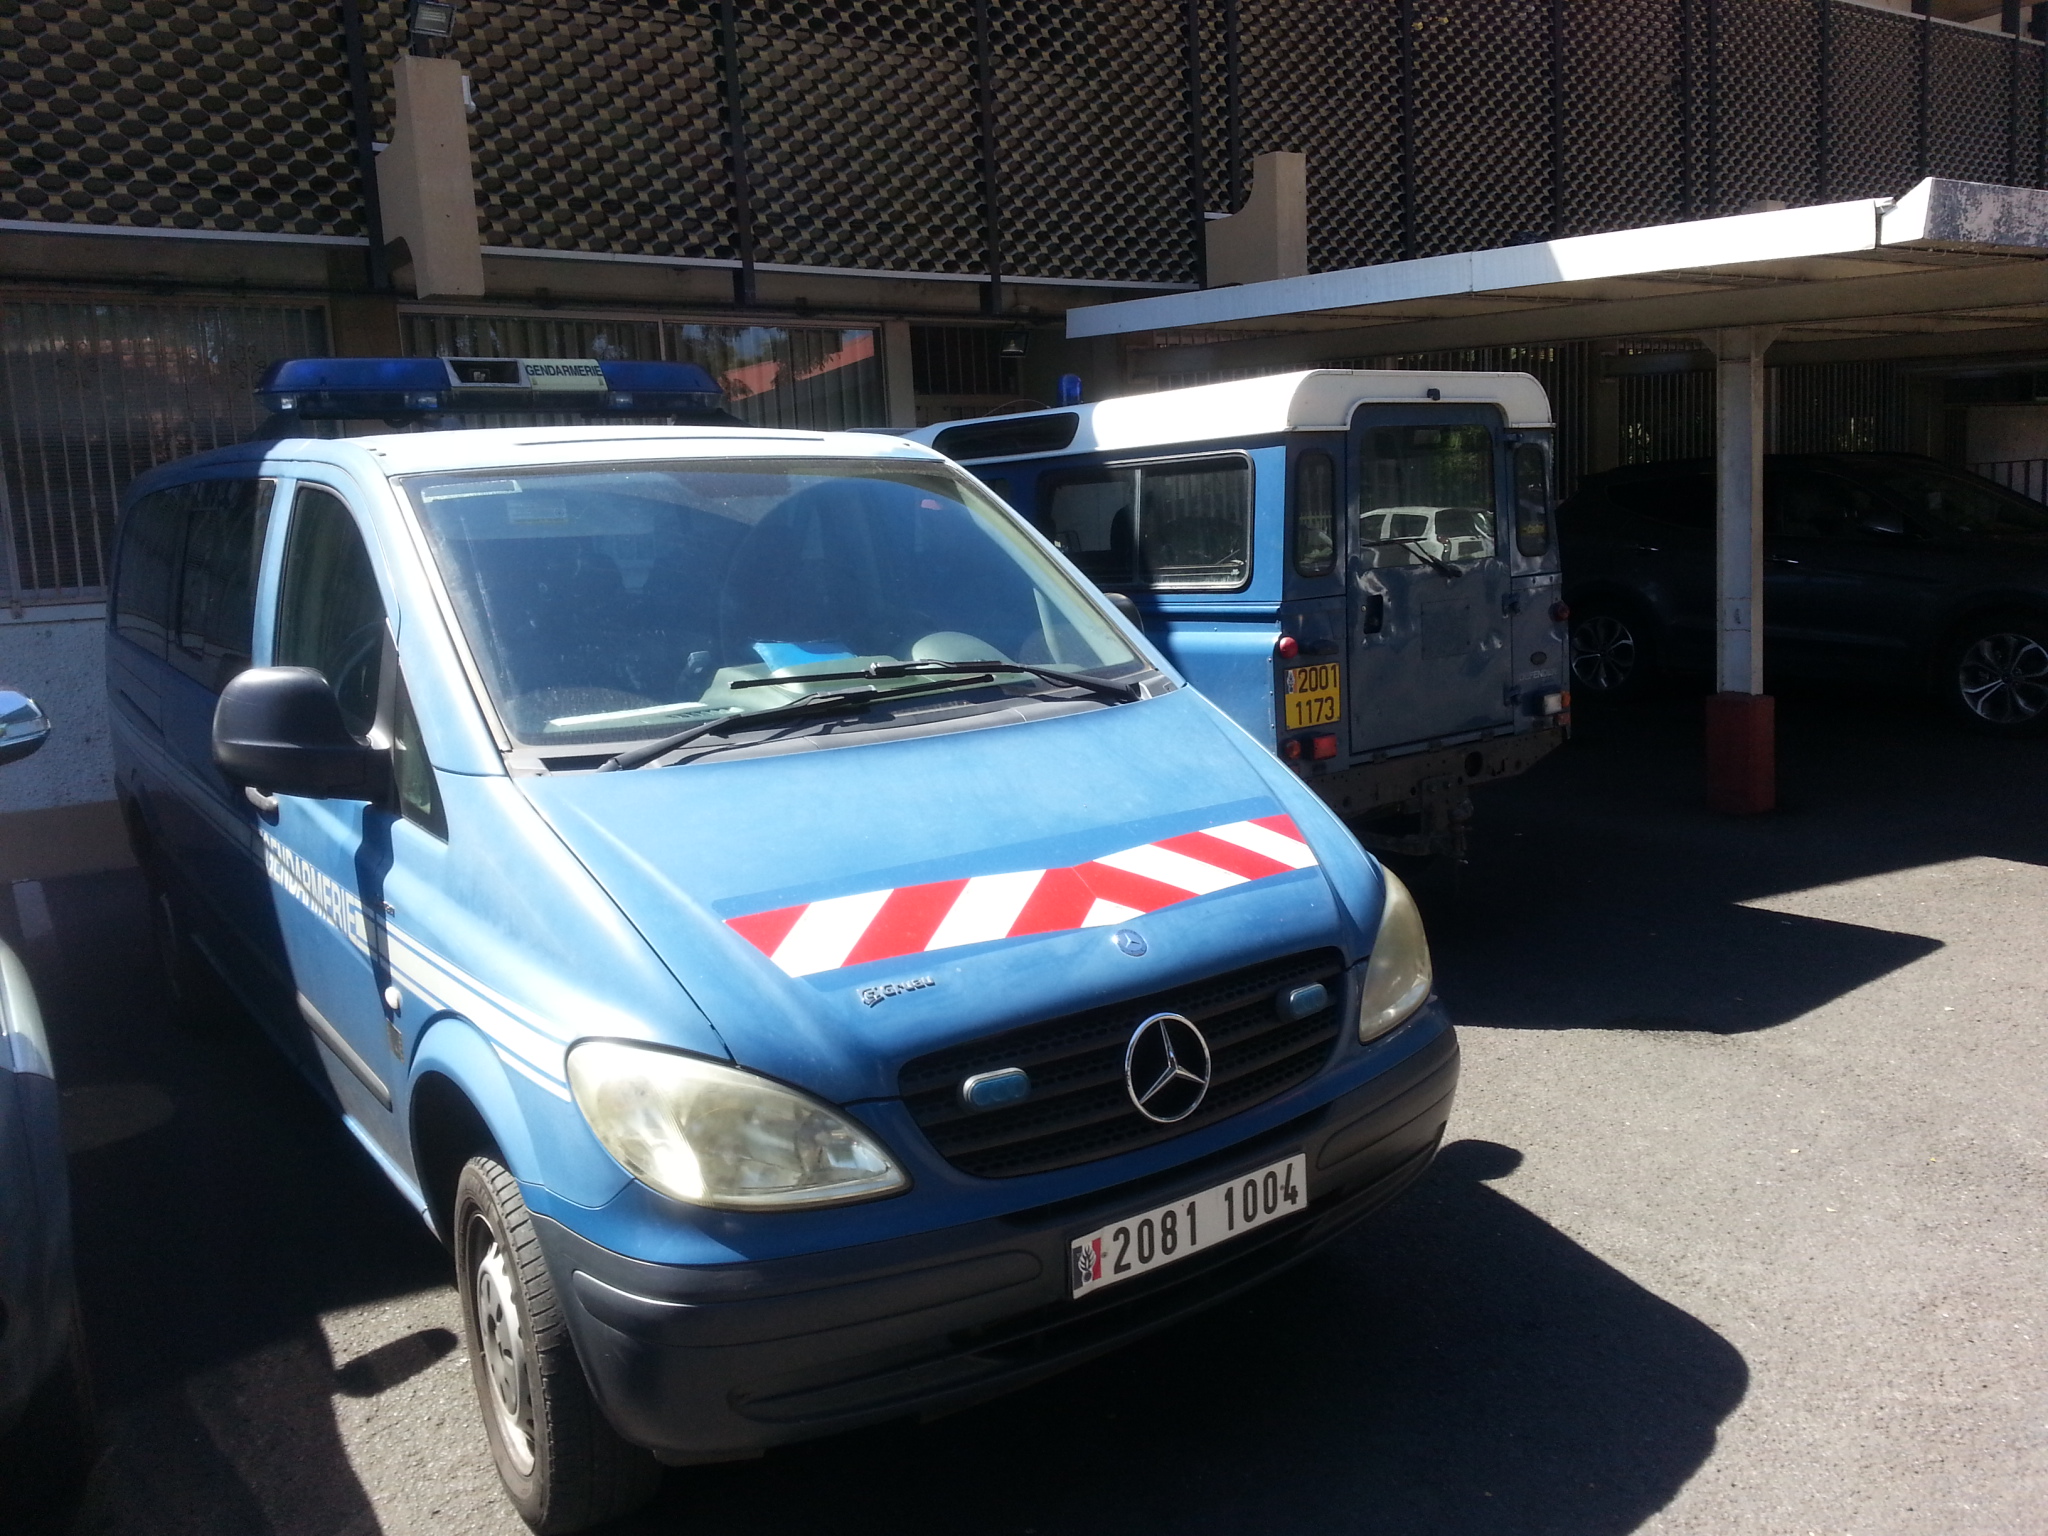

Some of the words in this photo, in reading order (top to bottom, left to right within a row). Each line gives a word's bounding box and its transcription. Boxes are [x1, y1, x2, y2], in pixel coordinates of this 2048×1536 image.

[525, 365, 603, 376] GENDARMERIE
[1298, 665, 1337, 693] 2001
[1296, 696, 1335, 725] 1173
[262, 832, 359, 947] GENDARMERIE
[1112, 1201, 1197, 1275] 2081
[1224, 1163, 1299, 1231] 1004
